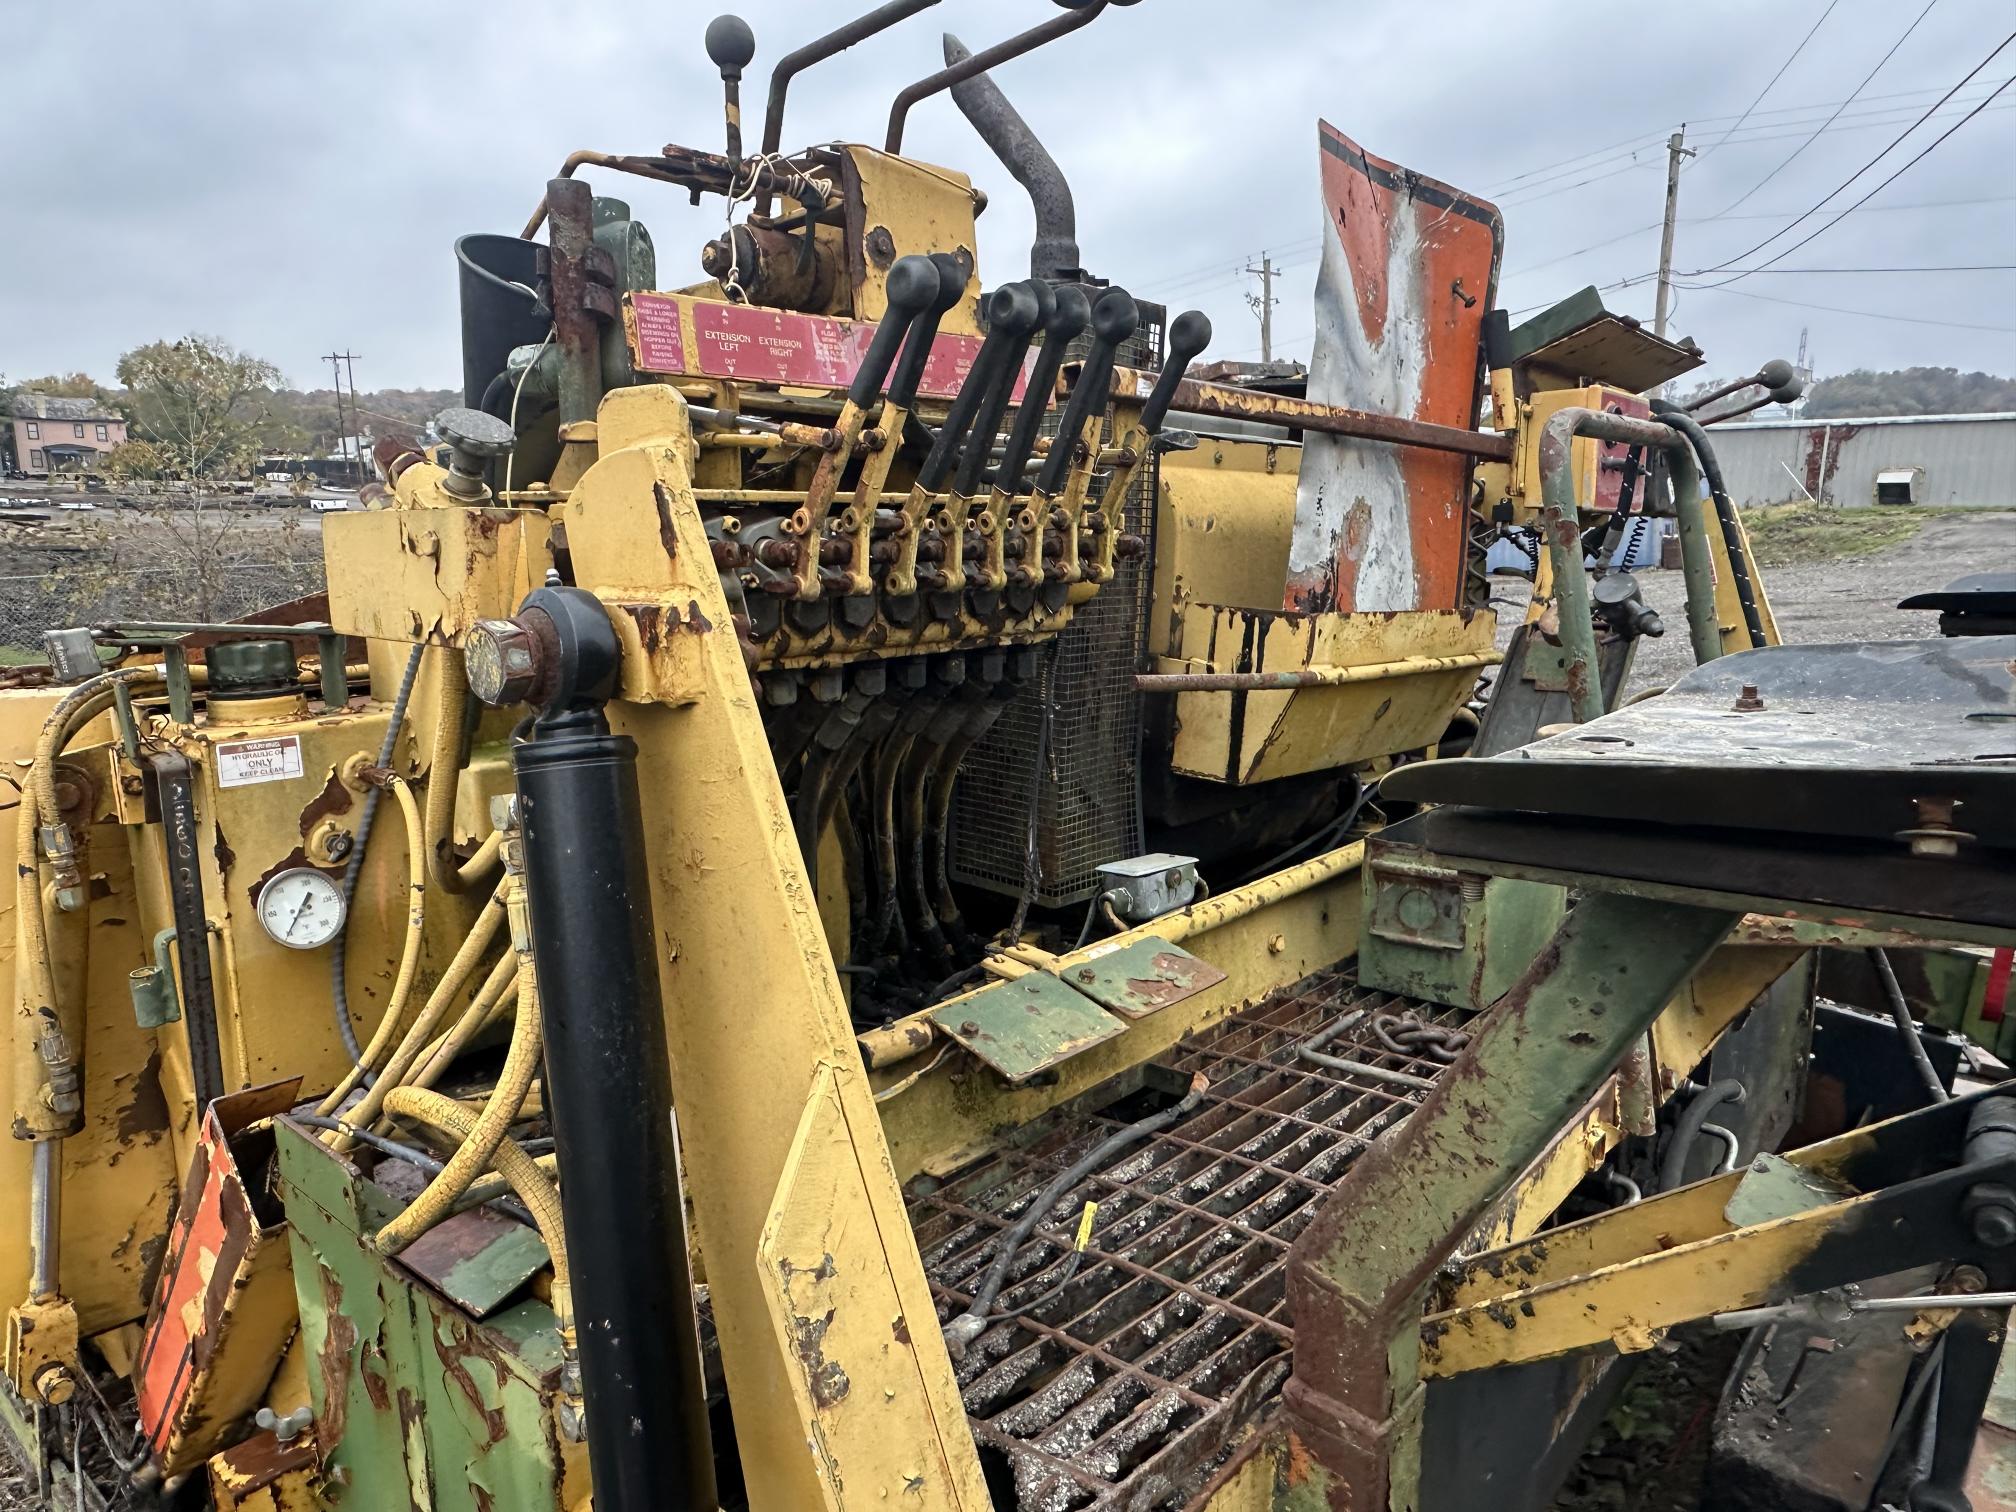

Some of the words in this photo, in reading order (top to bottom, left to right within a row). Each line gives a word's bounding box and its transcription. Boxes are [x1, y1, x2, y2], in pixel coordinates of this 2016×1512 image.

[704, 330, 751, 343] EXTENSION
[719, 342, 739, 352] LEFT
[758, 336, 802, 350] EXTENSION
[769, 347, 793, 358] RIGHT
[724, 358, 737, 366] OUT
[246, 741, 281, 750] WARNING
[232, 750, 274, 760] HYDRAULIC
[248, 758, 273, 768] ONLY
